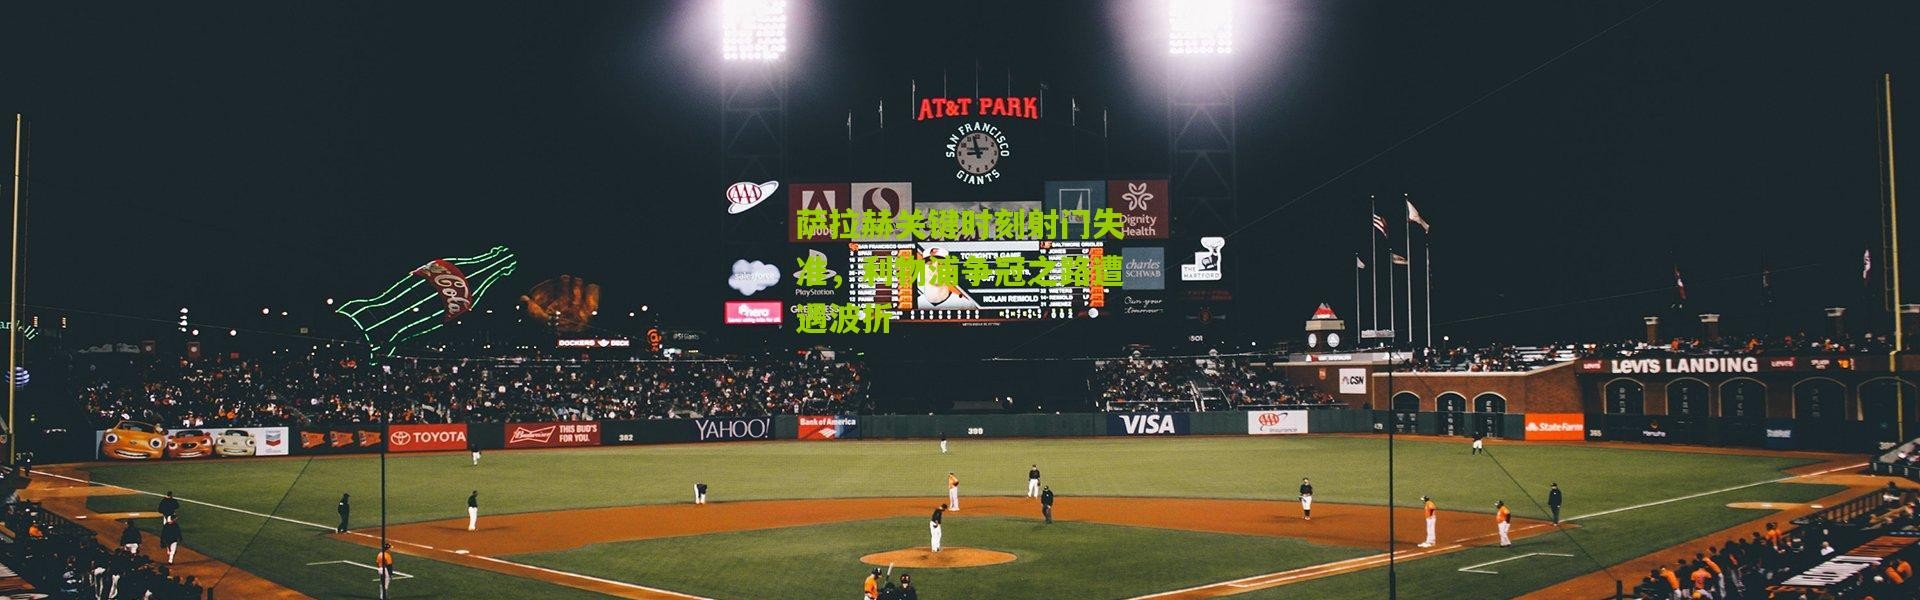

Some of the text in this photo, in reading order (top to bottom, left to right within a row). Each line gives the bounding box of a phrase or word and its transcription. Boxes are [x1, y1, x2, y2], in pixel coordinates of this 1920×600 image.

[918, 96, 1039, 121] AT&T PARK
[945, 121, 1010, 158] SAN FRANCISCO
[956, 168, 1001, 185] GIANTS
[1119, 213, 1158, 227] Dignity
[1121, 227, 1156, 237] Health
[1125, 258, 1160, 270] charles
[1125, 269, 1161, 279] SCHWAB
[1184, 272, 1221, 280] HARTFORD
[795, 288, 835, 298] PlayStation
[558, 339, 630, 347] DOCKERS DECK
[1666, 356, 1758, 374] LANDING
[1349, 376, 1364, 386] CSN
[800, 418, 818, 426] Bank
[828, 418, 857, 426] America
[1118, 414, 1176, 434] VISA
[559, 423, 598, 434] THIS BUD'S
[695, 418, 771, 441] YAHOO!
[413, 431, 467, 443] TOYOTA
[513, 429, 552, 440] Budweiser
[559, 433, 590, 443] FOR YOU.
